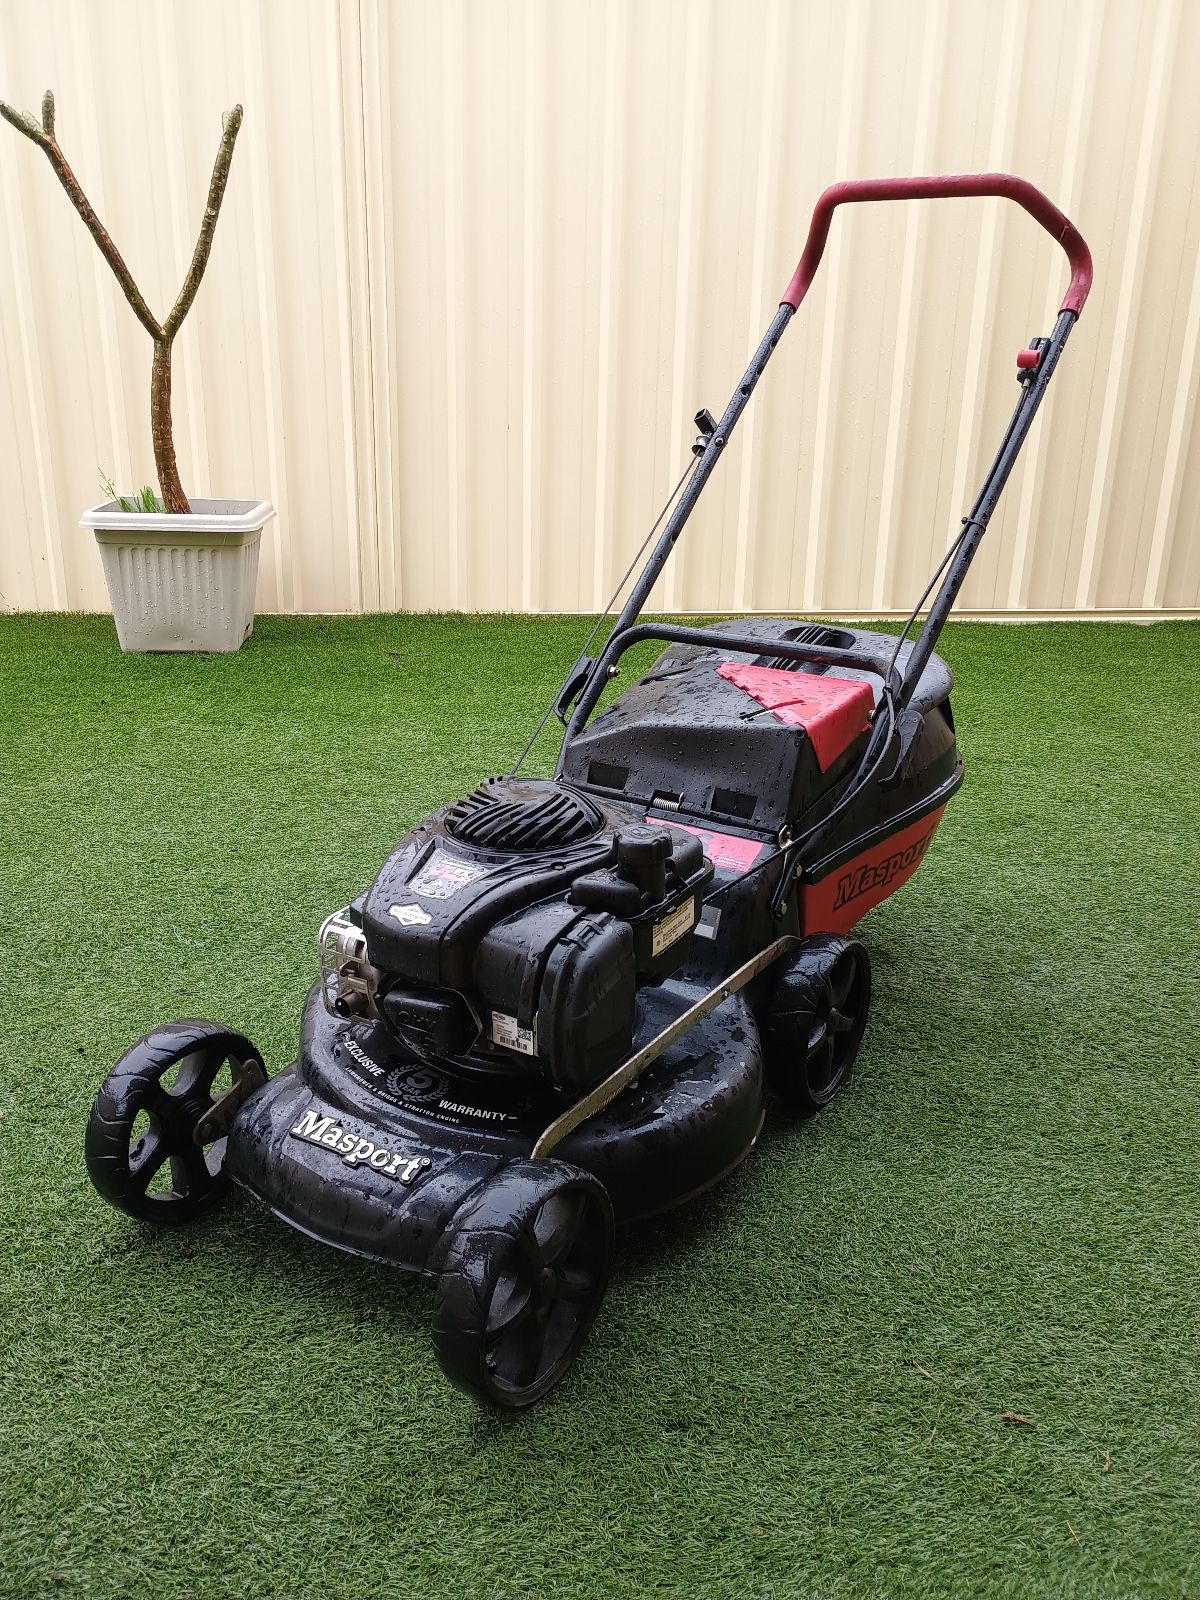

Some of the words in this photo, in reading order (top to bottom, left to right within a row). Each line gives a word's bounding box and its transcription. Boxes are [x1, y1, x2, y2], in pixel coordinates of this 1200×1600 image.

[344, 1041, 385, 1077] EXCLUSIVE
[399, 1082, 421, 1096] YEAR
[406, 1067, 440, 1089] 5
[403, 1103, 435, 1117] STRATTON
[436, 1114, 460, 1124] ENGINE
[438, 1099, 508, 1121] WARRANTY
[291, 1110, 422, 1182] Masport
